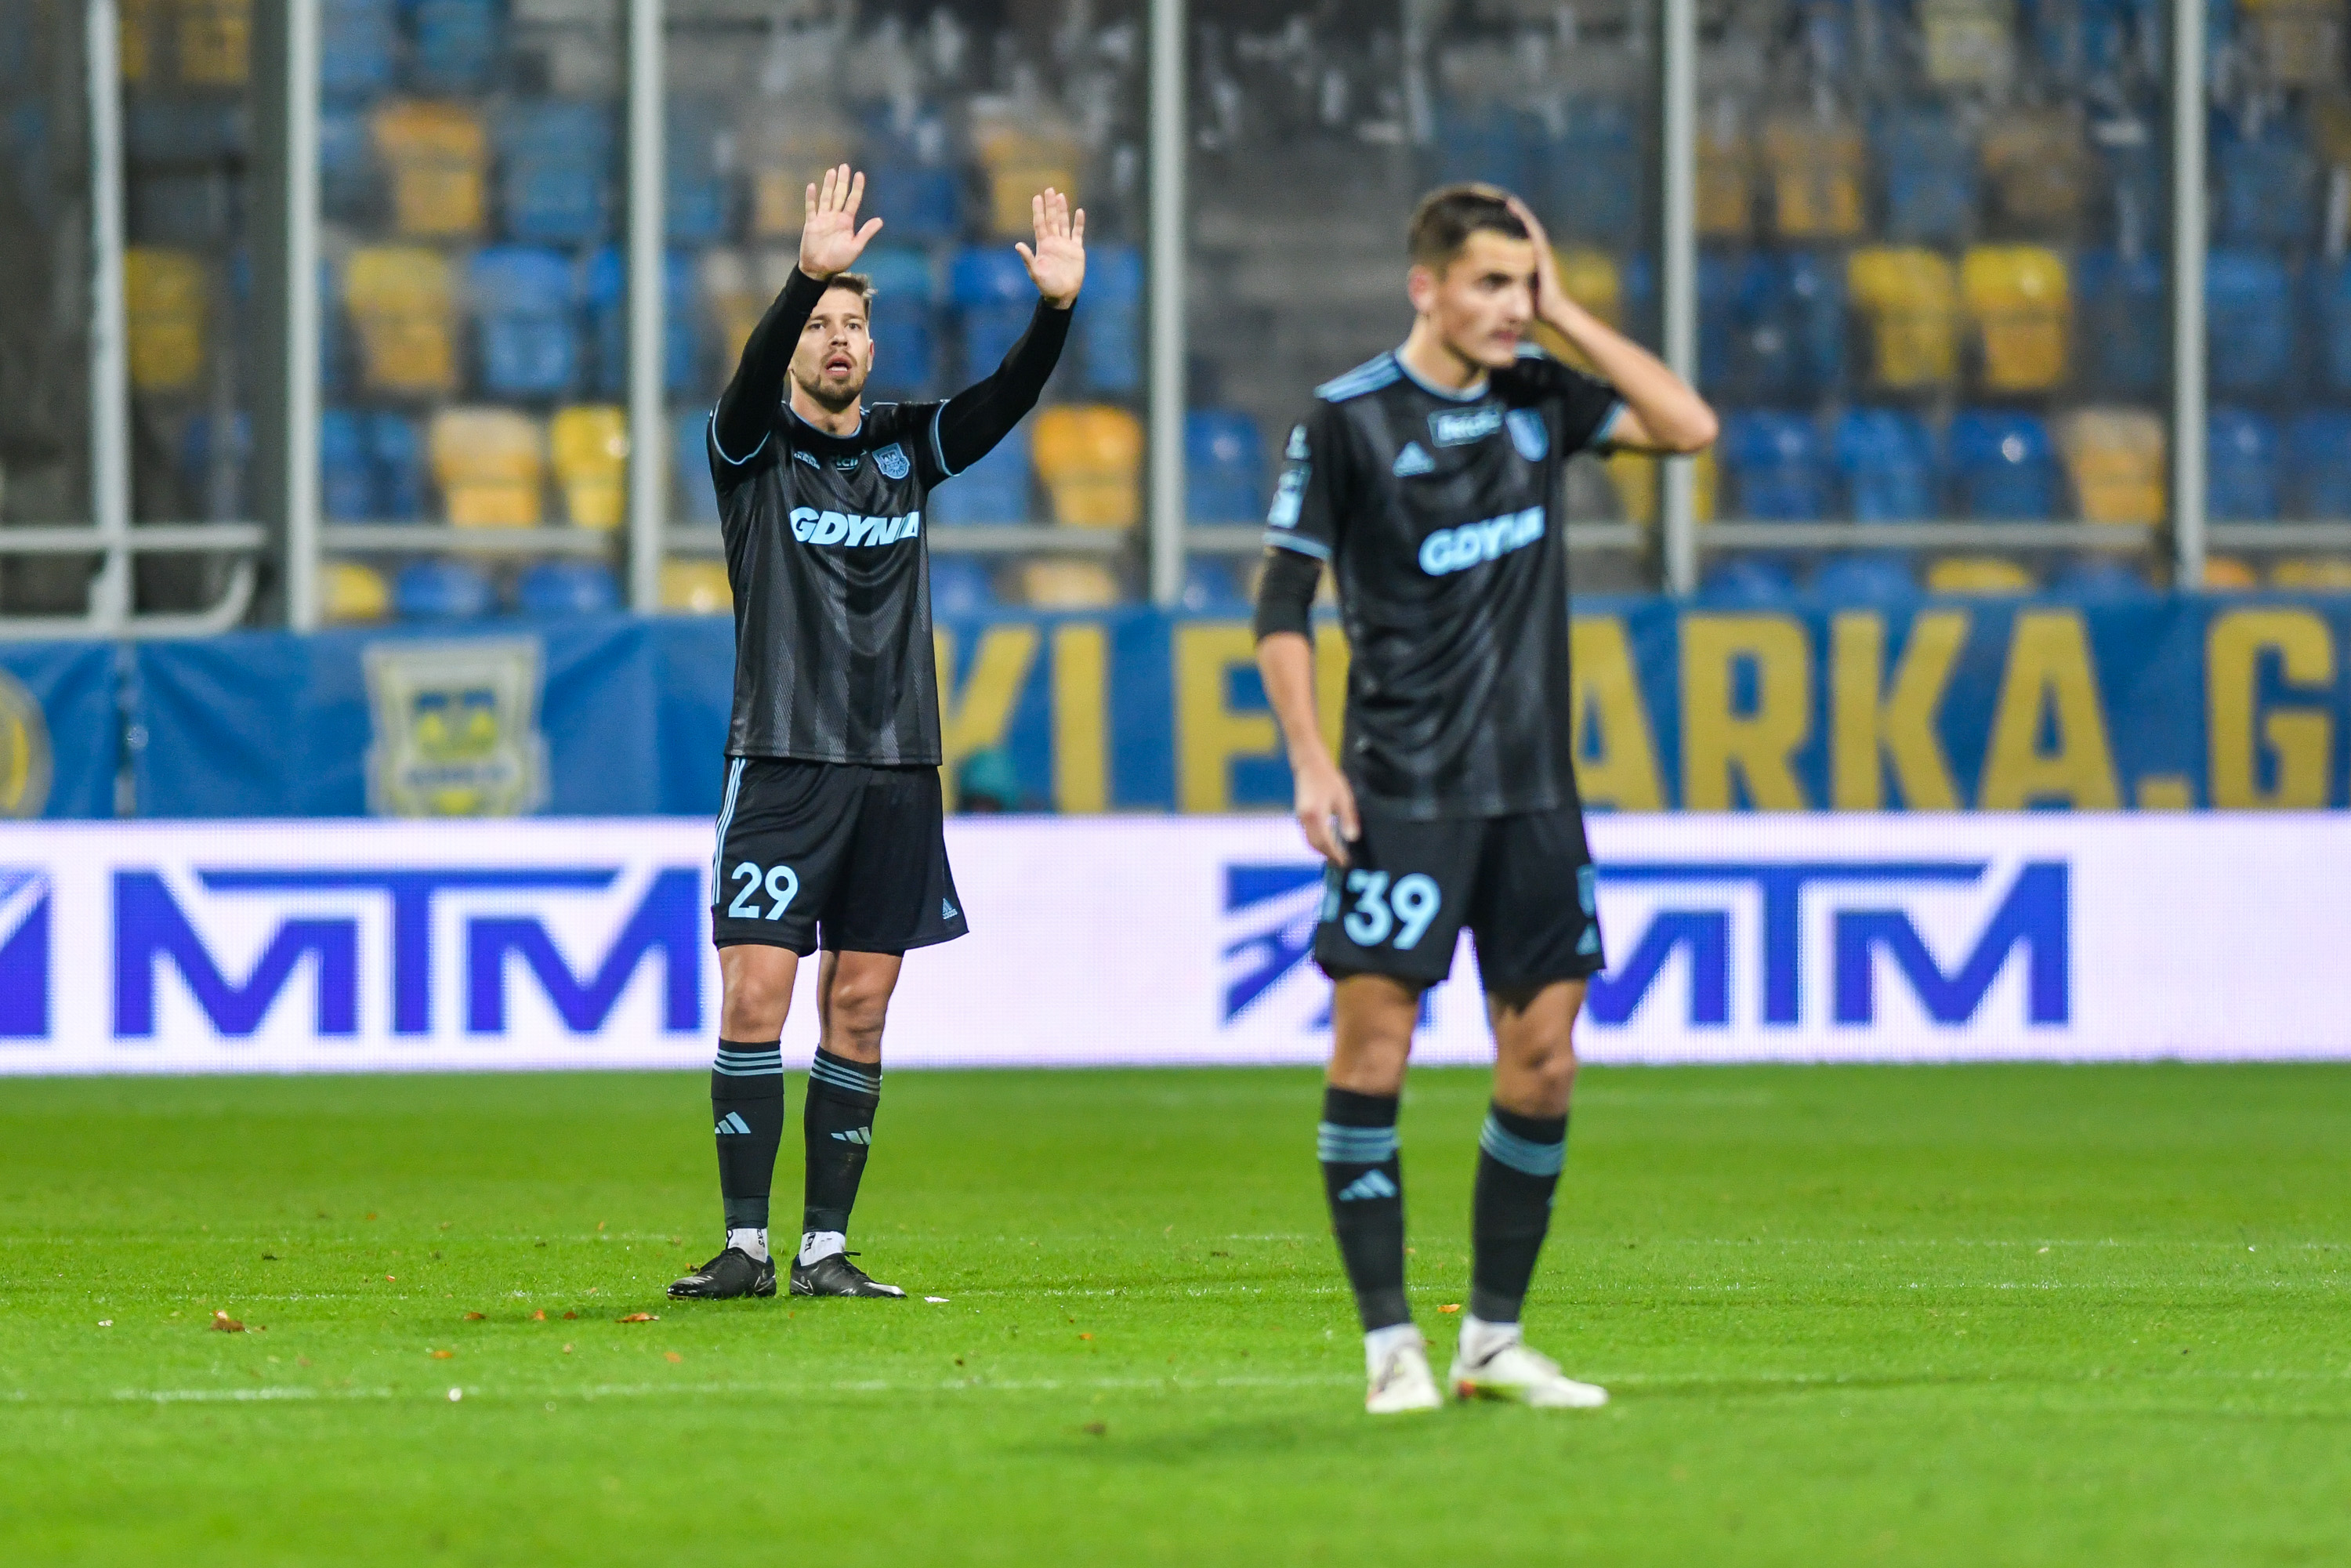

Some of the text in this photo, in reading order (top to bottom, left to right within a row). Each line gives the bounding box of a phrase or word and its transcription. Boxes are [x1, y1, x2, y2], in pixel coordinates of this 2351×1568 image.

[728, 862, 799, 921] 29
[1344, 868, 1441, 950] 39
[113, 867, 702, 1038] MTM
